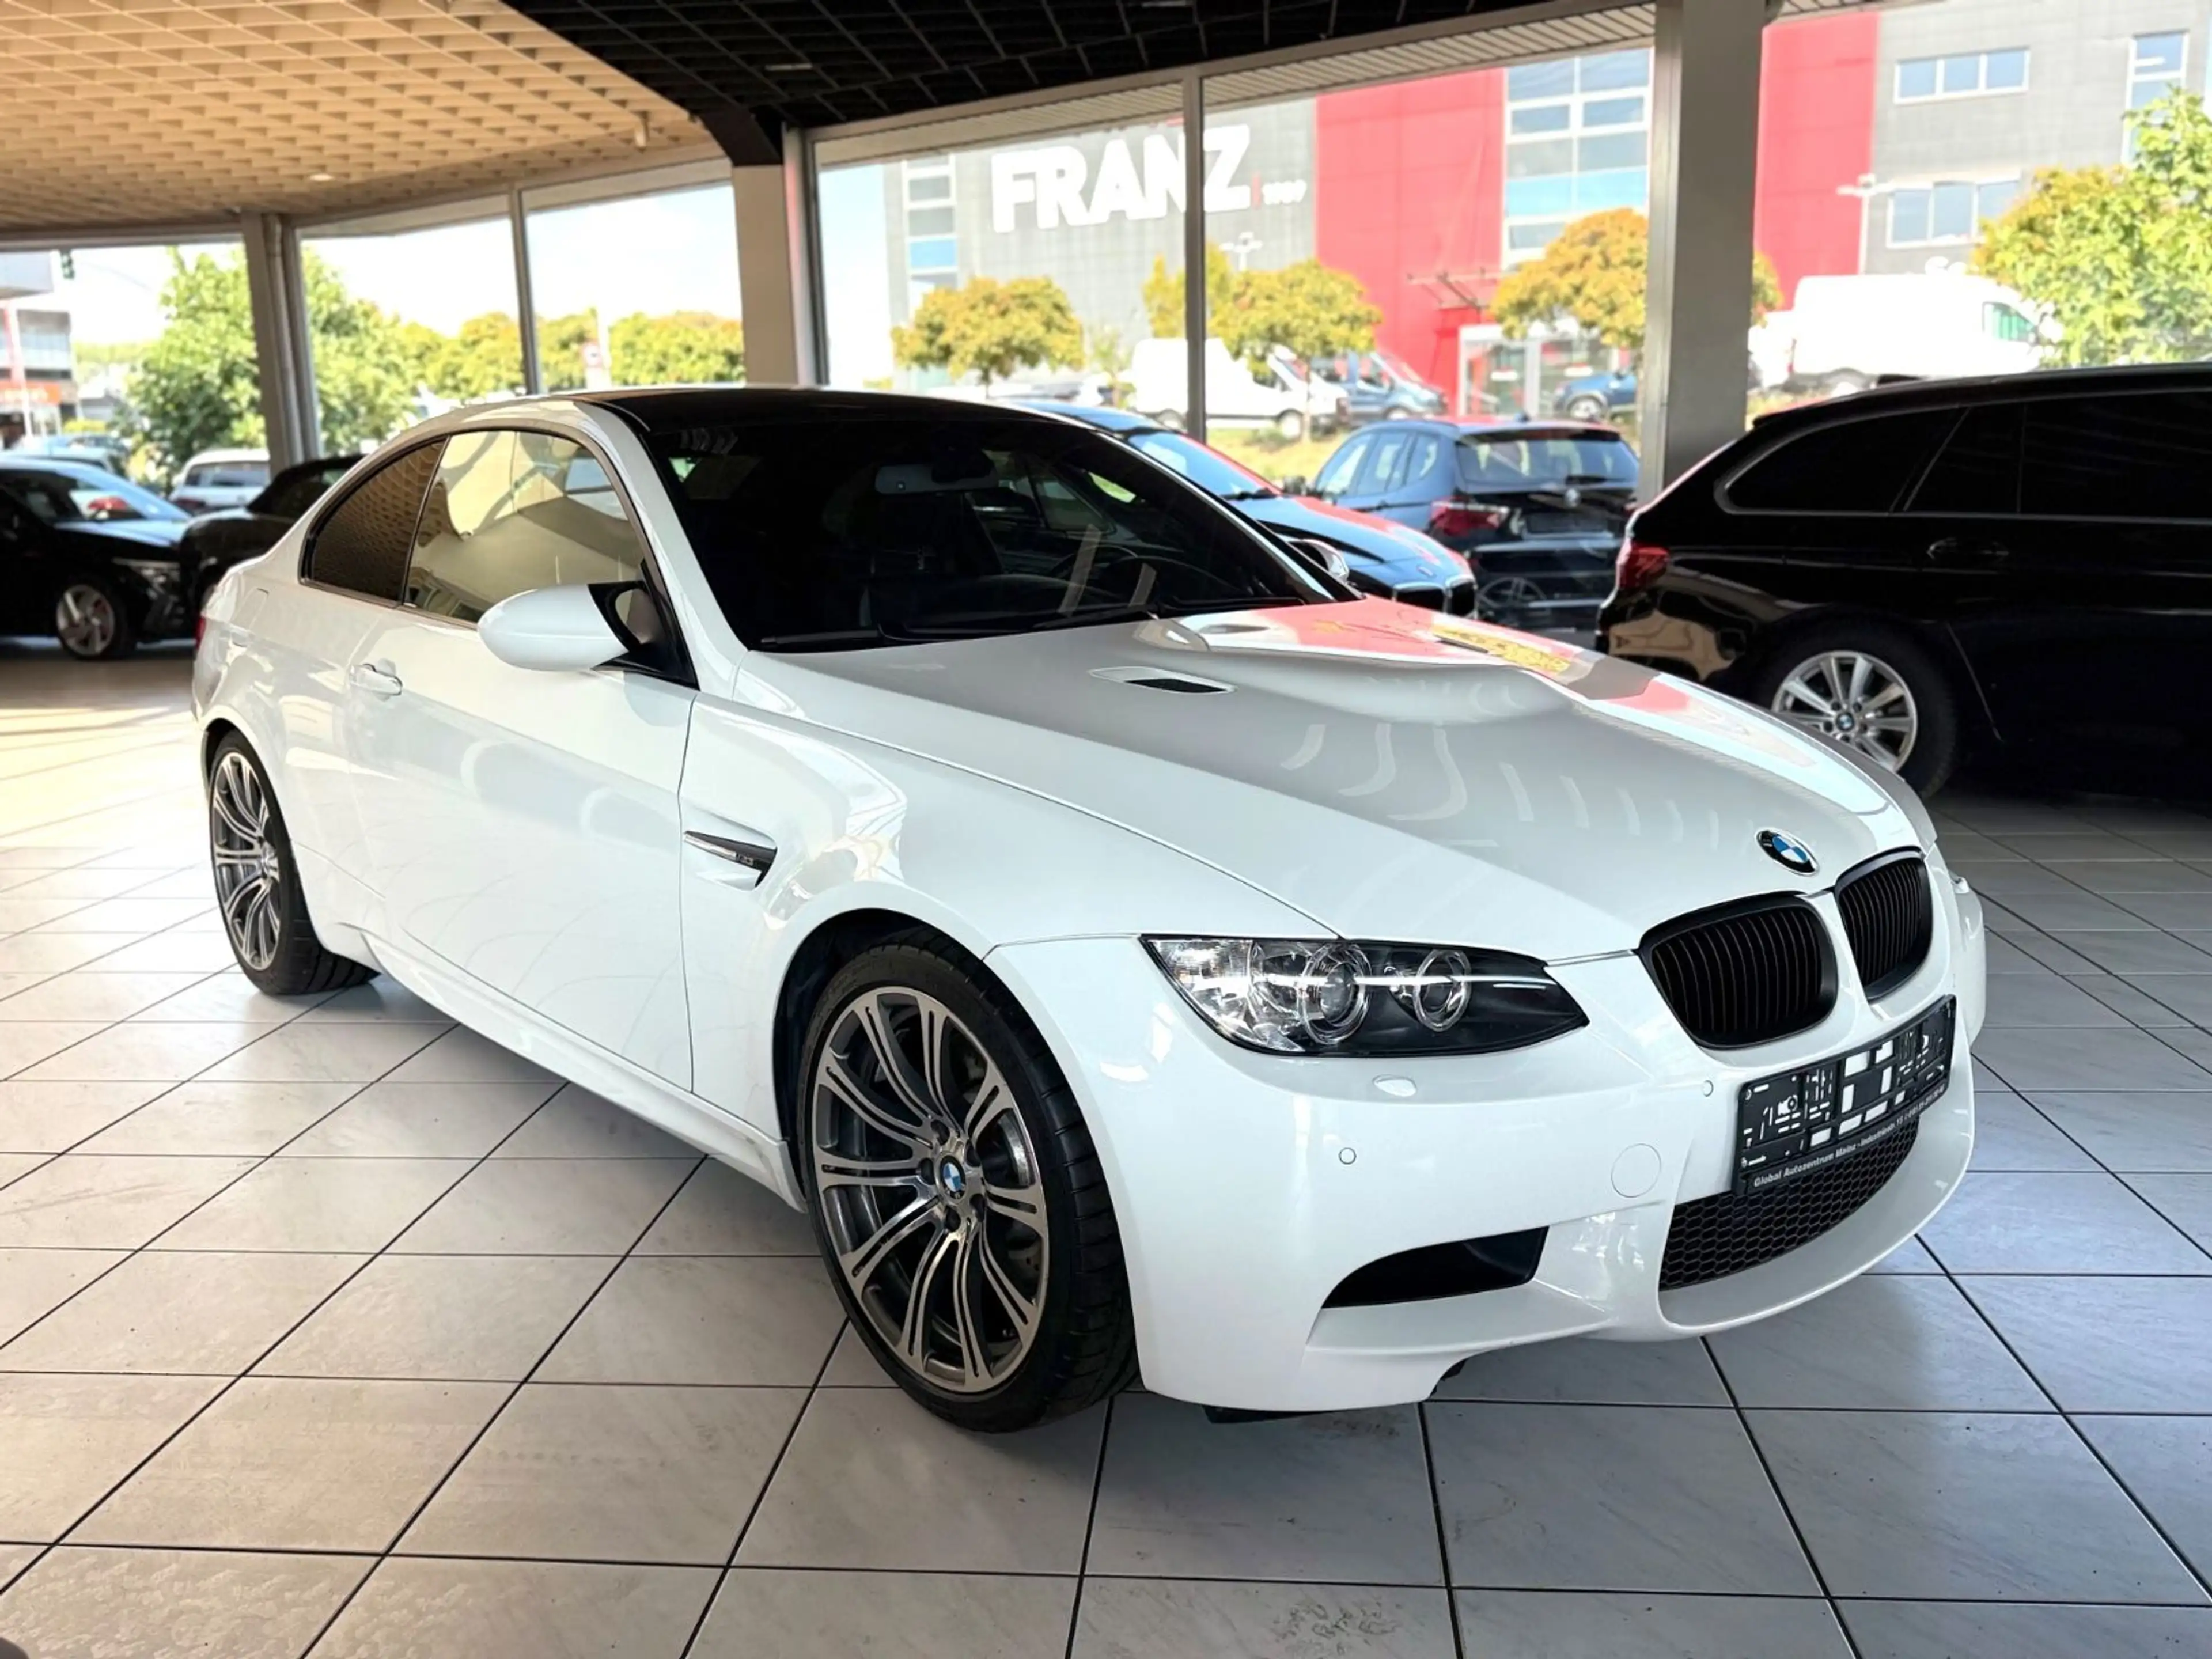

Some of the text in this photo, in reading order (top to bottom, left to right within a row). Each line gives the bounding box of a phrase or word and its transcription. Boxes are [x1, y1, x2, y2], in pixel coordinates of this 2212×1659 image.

[991, 124, 1251, 233] FRANZ
[1754, 1169, 1782, 1187] Global
[1784, 1153, 1834, 1177] Autozentrum
